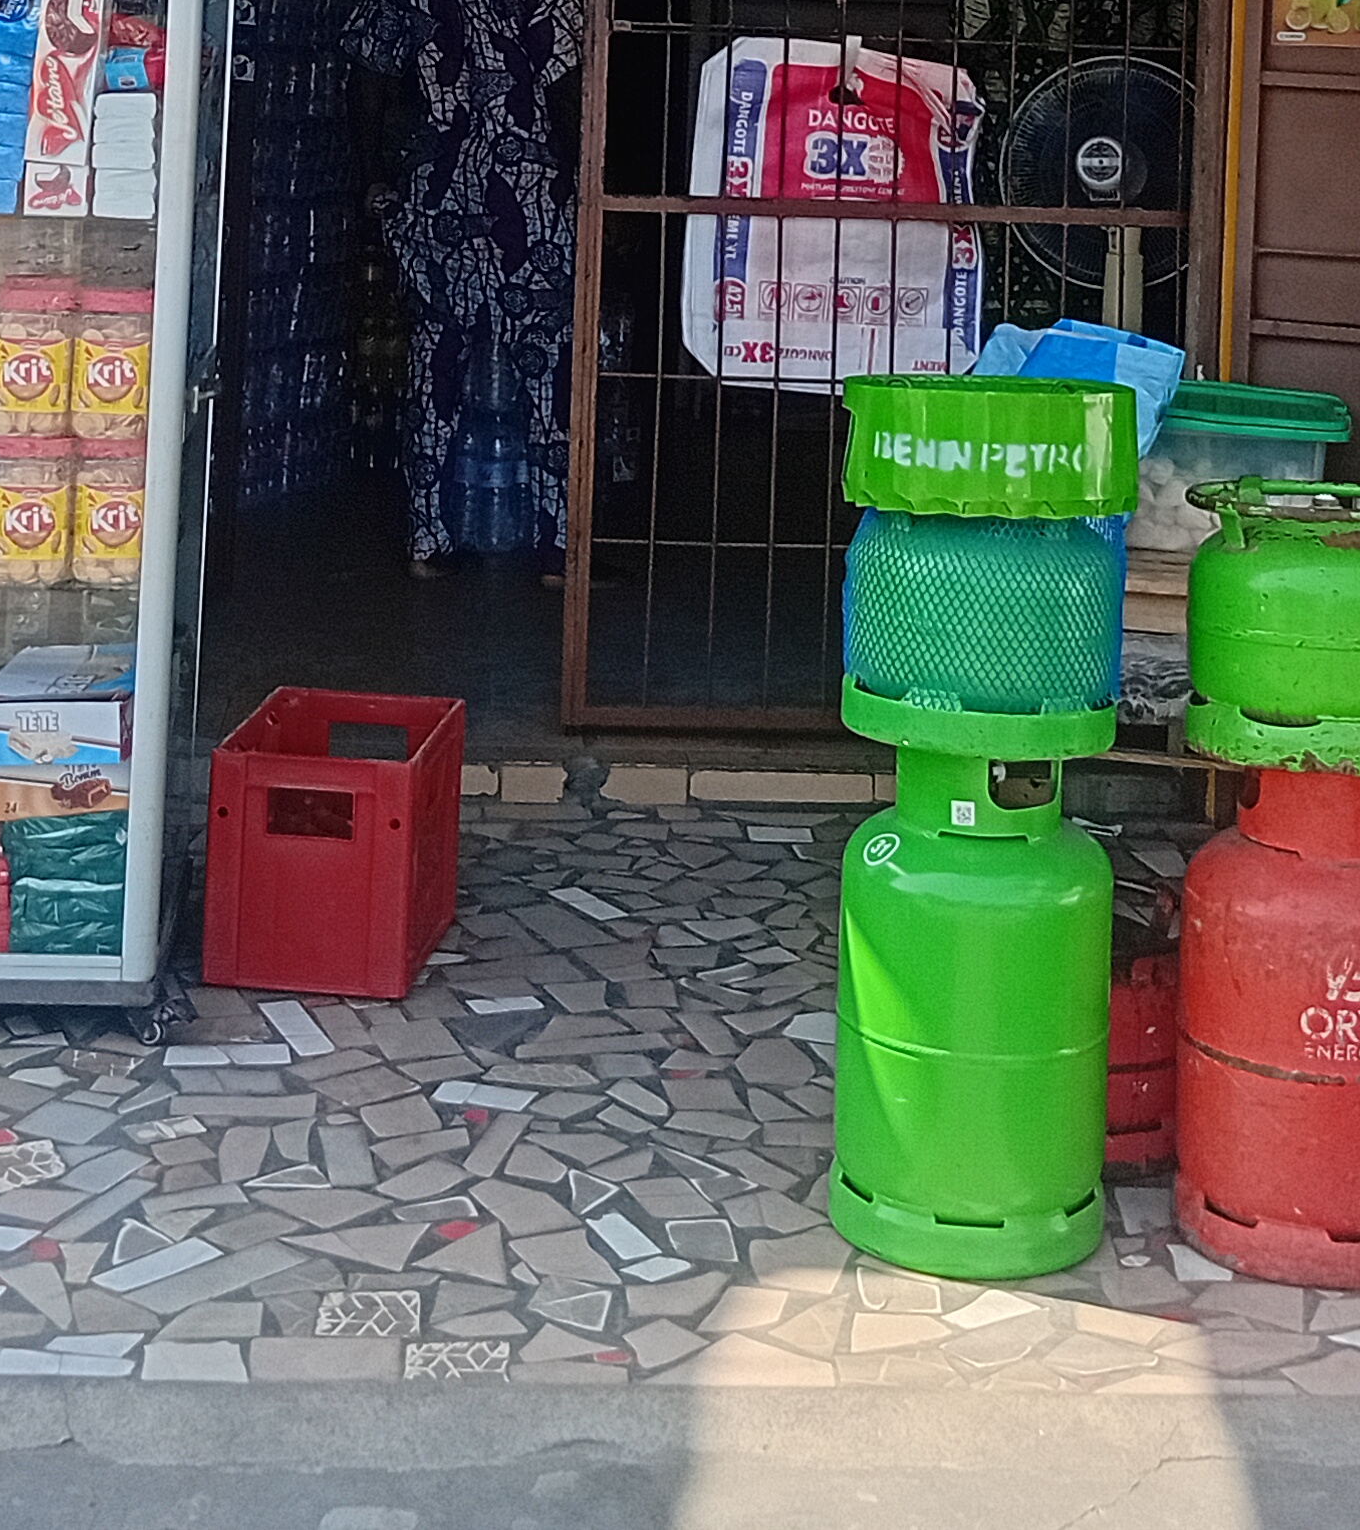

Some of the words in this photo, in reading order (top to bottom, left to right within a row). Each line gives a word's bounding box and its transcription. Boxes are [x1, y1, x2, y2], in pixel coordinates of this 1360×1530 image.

[733, 91, 753, 155] DANGOTE
[808, 109, 895, 135] DANGOTE
[808, 135, 869, 177] 3X
[953, 272, 968, 336] DANGOTE
[741, 341, 774, 363] 3X
[4, 354, 52, 386] Krit
[88, 356, 135, 387] Krit
[874, 431, 972, 472] BENIN
[5, 501, 54, 533] Krit
[91, 503, 139, 533] Krit
